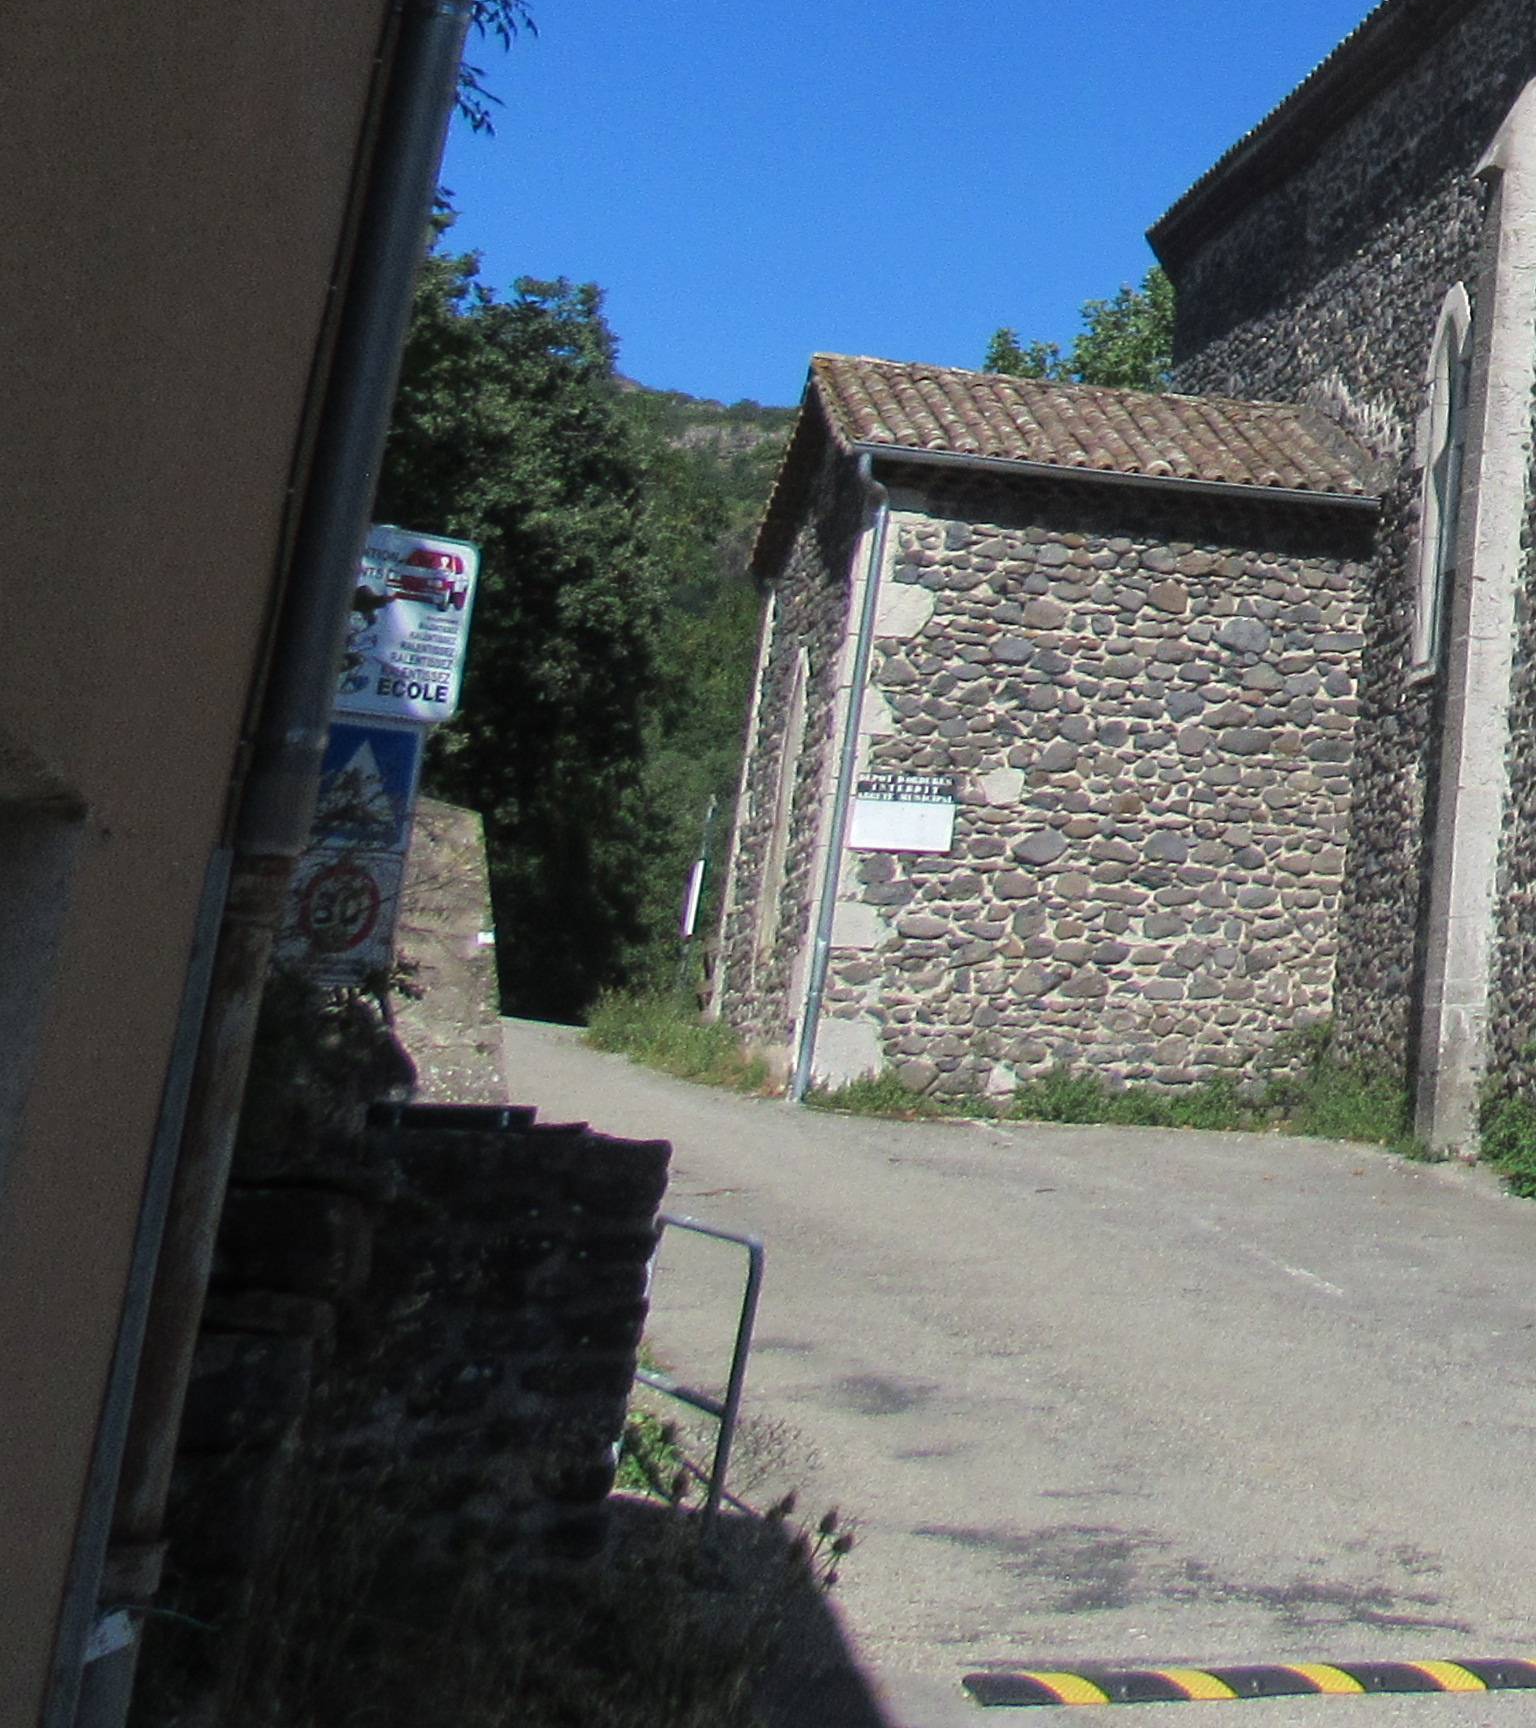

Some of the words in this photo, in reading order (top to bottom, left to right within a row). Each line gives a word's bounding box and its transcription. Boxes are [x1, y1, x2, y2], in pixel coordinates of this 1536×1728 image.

[391, 651, 454, 670] RALENTISSEZ
[377, 677, 449, 703] ECOLE
[871, 783, 940, 794] INTERDIT
[900, 793, 952, 804] MUNICIPAL
